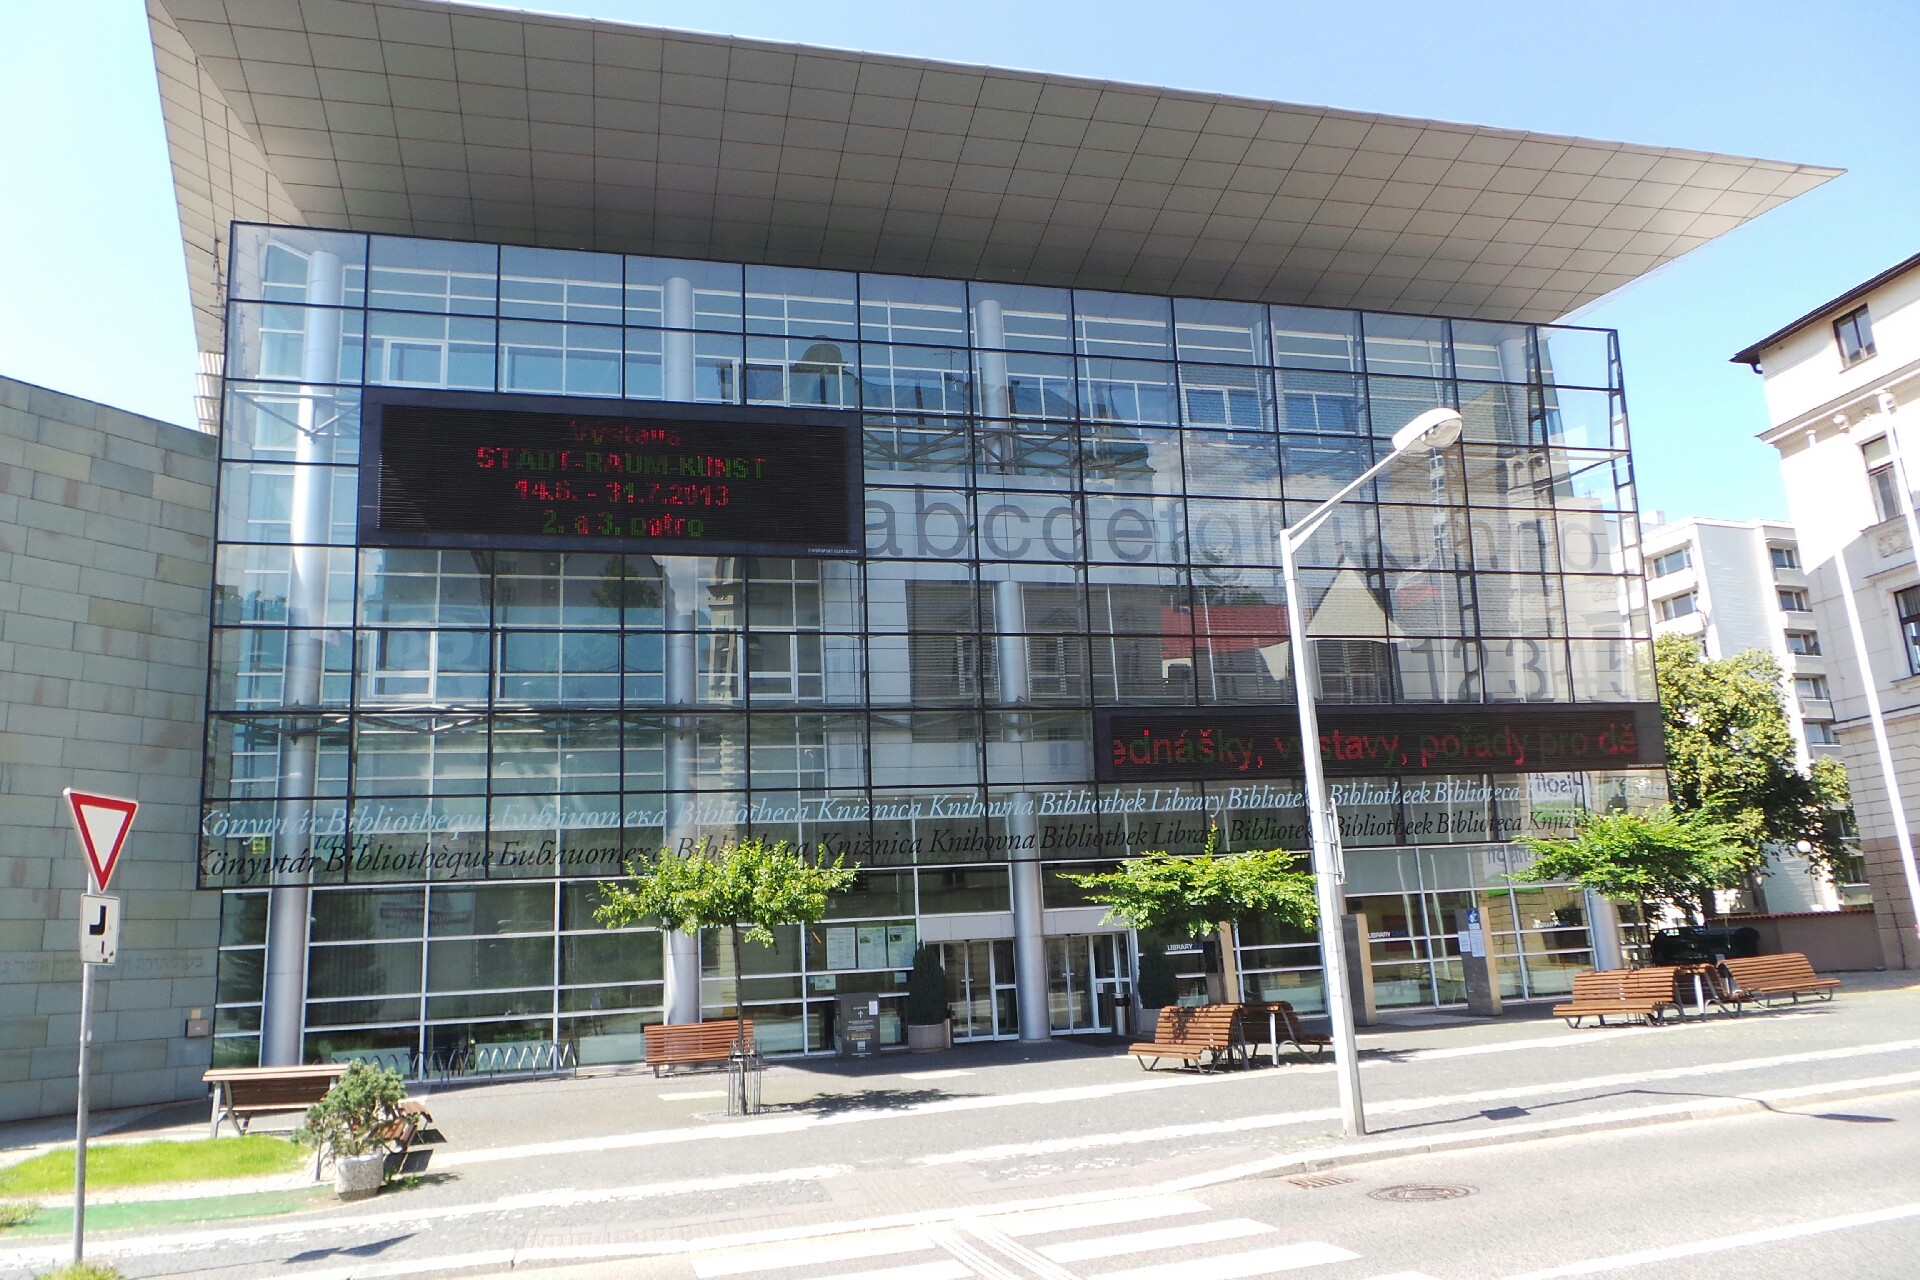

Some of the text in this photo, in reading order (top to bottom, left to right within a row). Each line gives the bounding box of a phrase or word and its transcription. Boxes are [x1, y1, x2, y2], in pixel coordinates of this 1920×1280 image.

[1275, 728, 1408, 768] vstavy,
[326, 804, 493, 841] Bibliothèque
[677, 797, 807, 825] Bibliotheca
[929, 793, 1034, 818] Knihovna
[1038, 788, 1146, 815] Bibliothek
[1150, 787, 1225, 818] Library
[1329, 781, 1431, 806] Bibliotheek
[1434, 779, 1521, 803] Biblioteca
[326, 841, 493, 878] Bibliothèque
[929, 828, 1035, 853] Knihovna
[1040, 821, 1148, 848] Bibliothek
[1152, 819, 1226, 851] Libray
[1167, 943, 1193, 951] LIBRARY
[1368, 931, 1391, 939] LIBRARY
